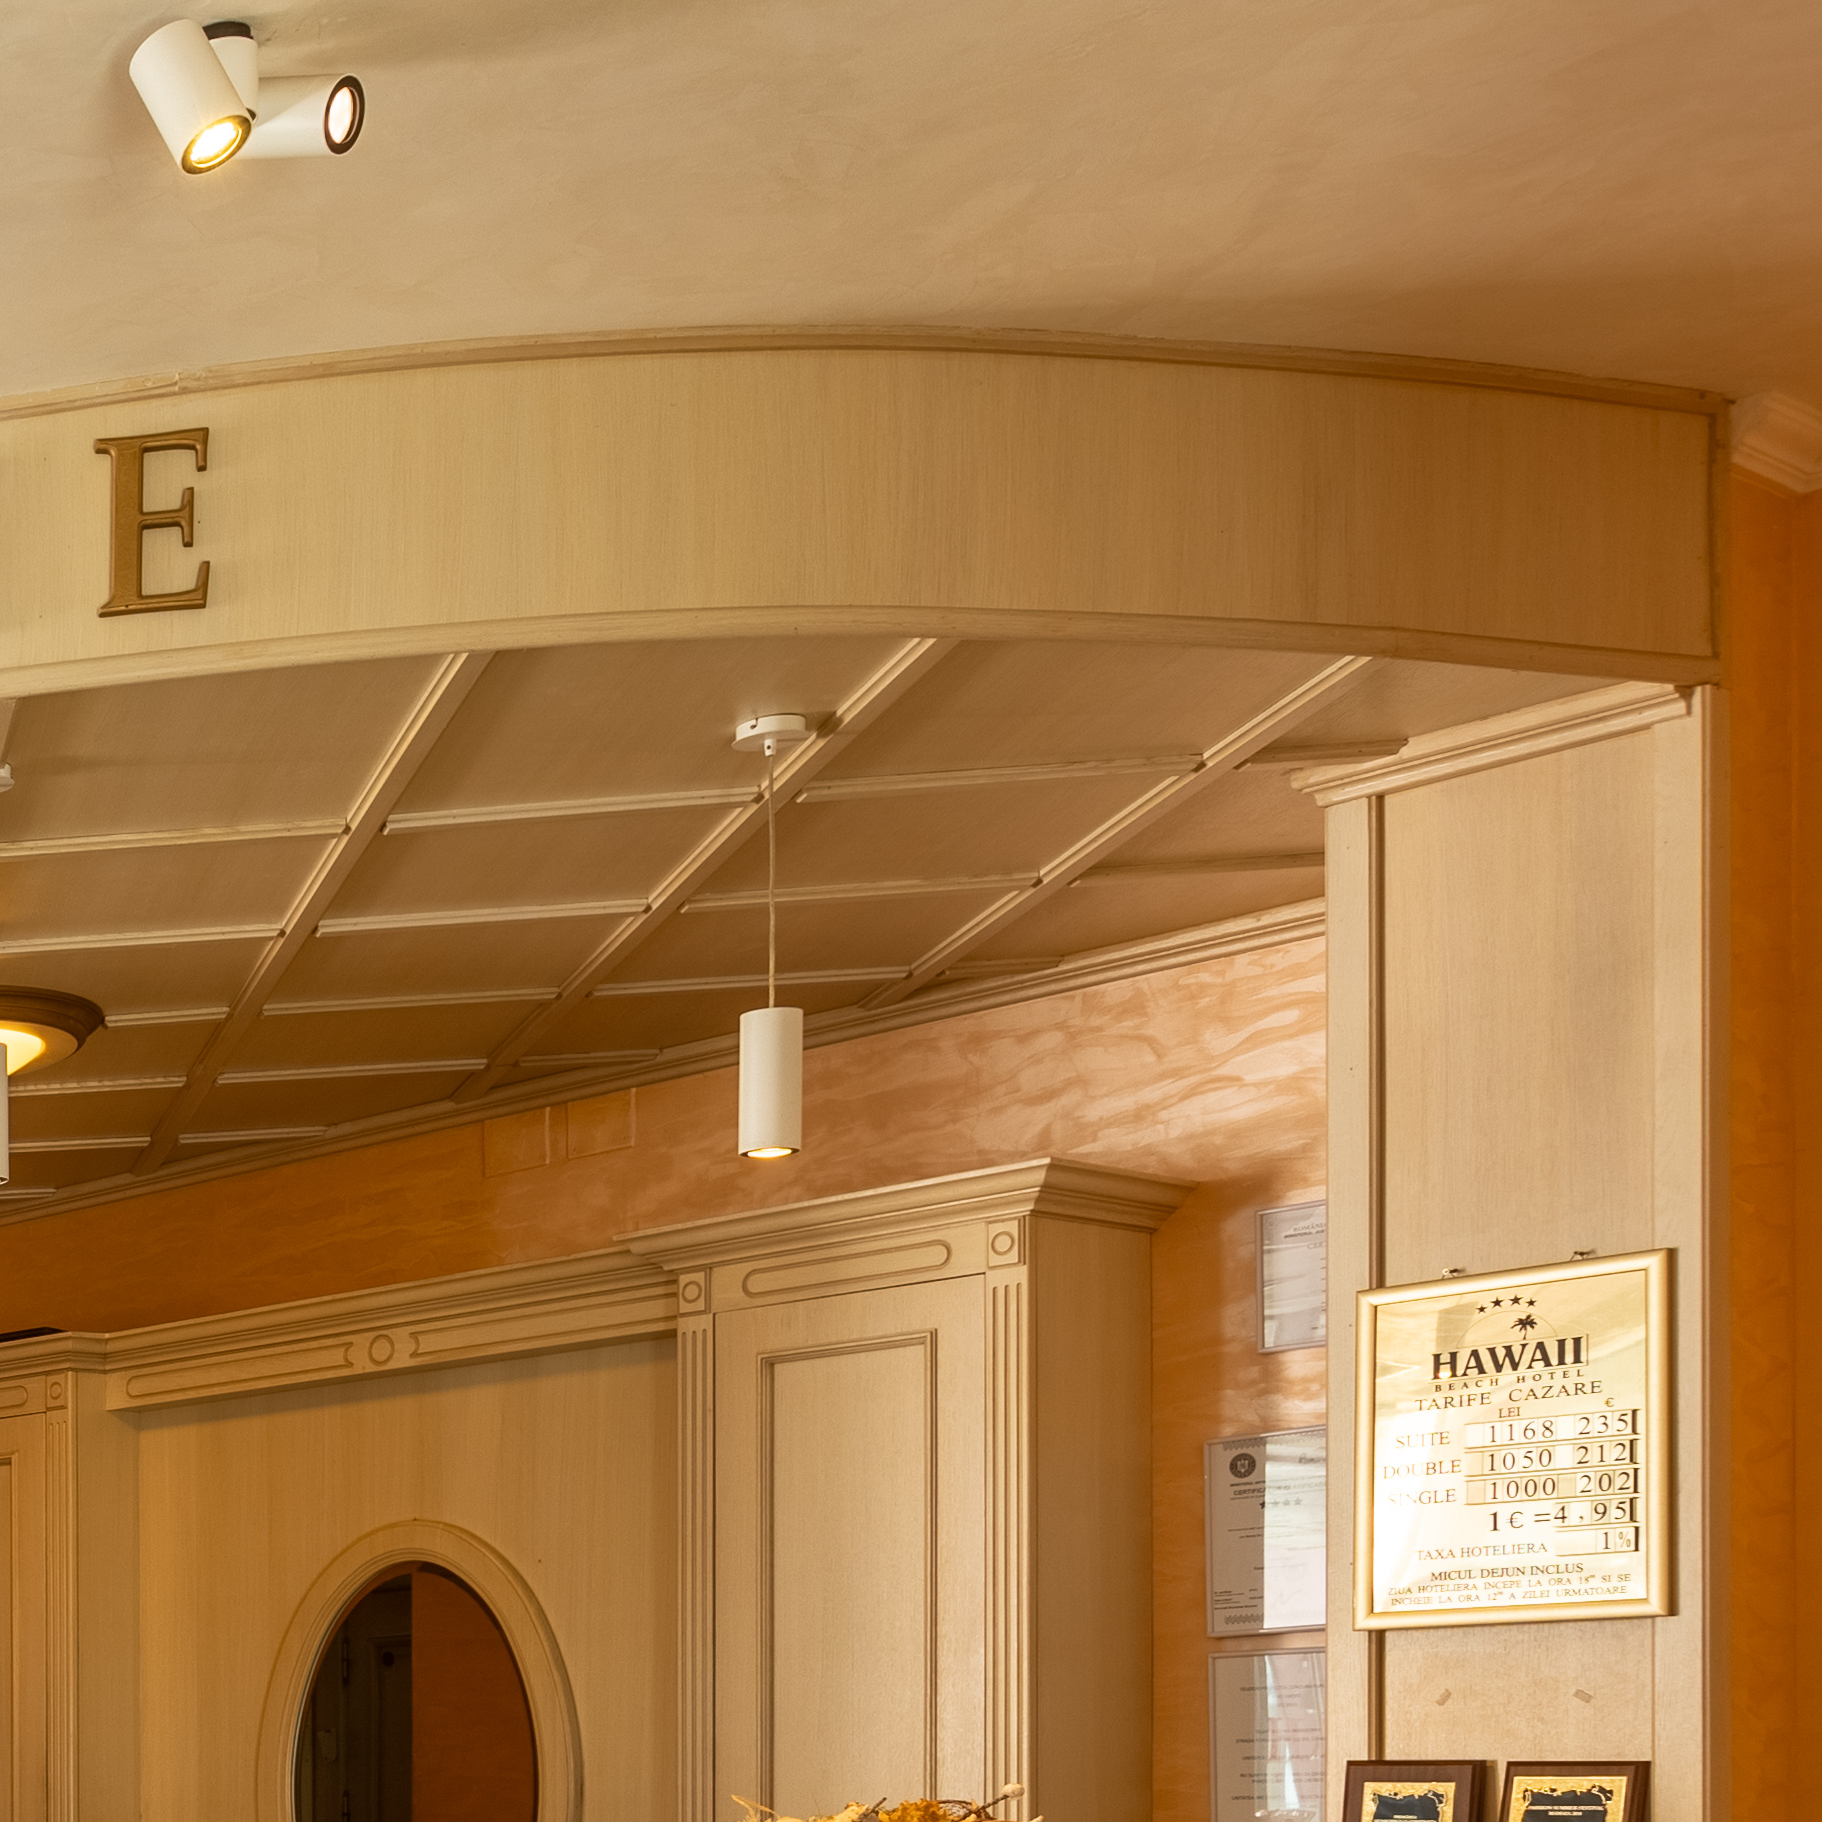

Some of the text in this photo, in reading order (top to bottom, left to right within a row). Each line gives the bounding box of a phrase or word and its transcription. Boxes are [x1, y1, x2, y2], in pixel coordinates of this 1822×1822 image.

[1430, 1336, 1585, 1380] HAWAII
[1434, 1368, 1585, 1393] BEACH HOTEL
[1414, 1380, 1603, 1412] TARIFE CAZARE
[1498, 1406, 1521, 1418] LEI
[1396, 1412, 1629, 1450] SUITE 1168 235
[1383, 1442, 1627, 1480] DOUBLE 1050 212
[1388, 1471, 1631, 1506] SINGLE 1000 202
[1489, 1510, 1500, 1532] 1
[1506, 1511, 1524, 1529] €
[1415, 1542, 1548, 1561] TAXA HOTELIERA
[1430, 1562, 1584, 1582] MICUL DEJUN INCLUS
[1418, 1583, 1478, 1594] HOTELIERA
[1483, 1580, 1523, 1590] INCEPE
[1528, 1578, 1542, 1588] LA
[1548, 1577, 1572, 1586] ORA
[1601, 1574, 1612, 1584] SI
[1617, 1574, 1632, 1583] SE
[1438, 1594, 1452, 1604] LA
[1458, 1592, 1480, 1603] ORA
[1509, 1592, 1516, 1600] A
[1522, 1588, 1550, 1599] ZILEI
[1556, 1586, 1627, 1597] URMATOARE
